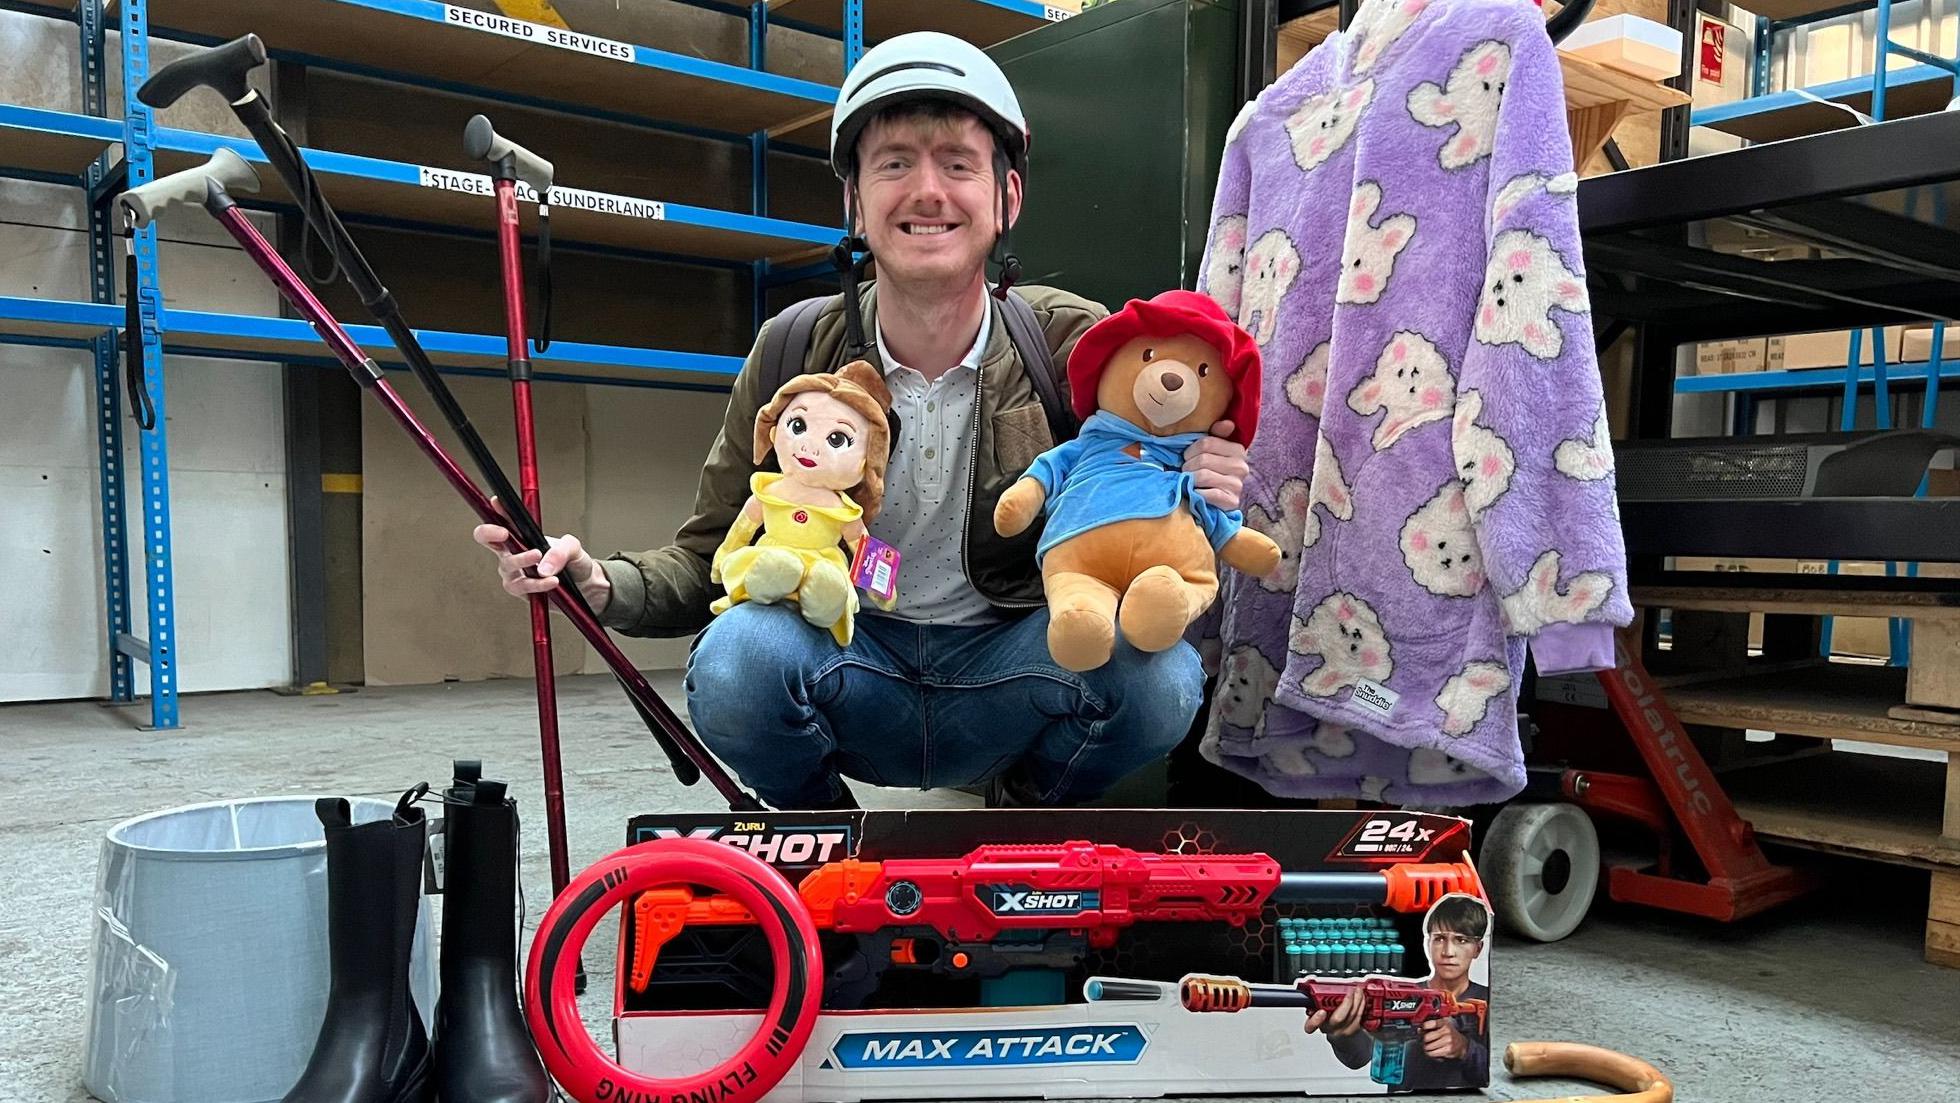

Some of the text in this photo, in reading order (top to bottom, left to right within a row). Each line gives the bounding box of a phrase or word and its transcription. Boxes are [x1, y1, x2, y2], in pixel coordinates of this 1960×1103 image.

[1048, 9, 1071, 21] SEC
[450, 8, 630, 59] SECURED SERVICES
[553, 190, 655, 219] SUNDERLAND
[1364, 684, 1375, 695] The
[733, 821, 766, 832] ZURU
[862, 1033, 1122, 1061] MAX ATTACK
